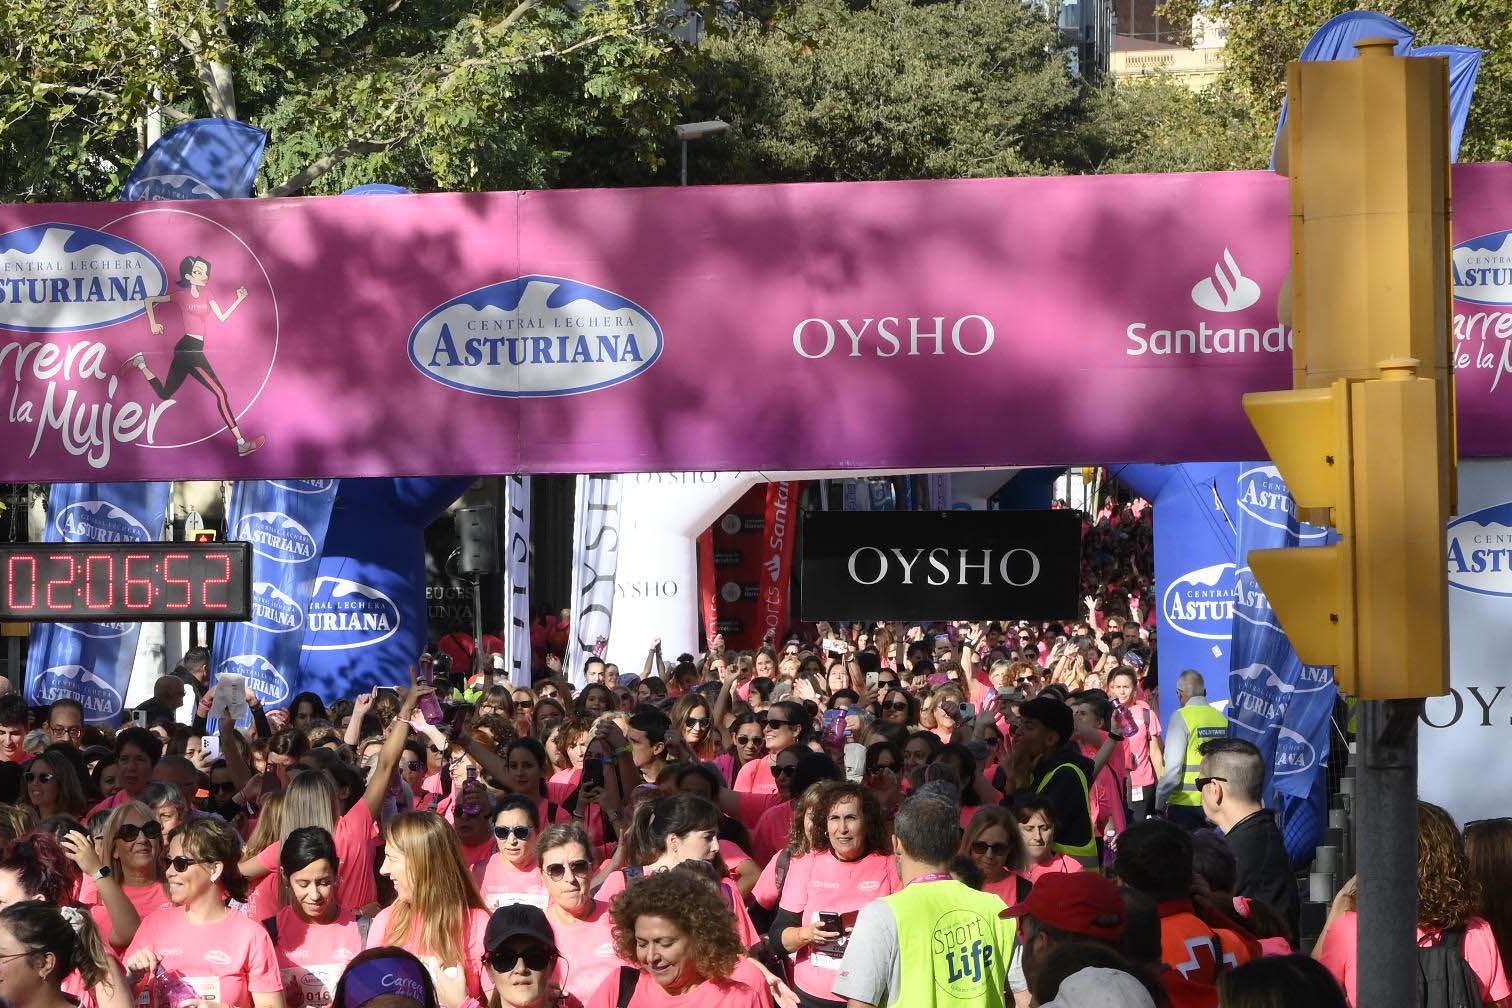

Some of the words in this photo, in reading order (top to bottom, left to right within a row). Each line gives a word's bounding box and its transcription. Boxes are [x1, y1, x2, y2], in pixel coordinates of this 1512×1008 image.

[71, 259, 142, 271] LECHERA
[1467, 256, 1512, 265] CENTRA
[467, 318, 542, 331] CENTRAL
[554, 316, 635, 329] LECHERA
[792, 315, 995, 359] OYSHO
[1126, 319, 1294, 357] Santand
[428, 323, 644, 367] ASTURIANA
[1476, 341, 1494, 369] la
[9, 383, 33, 424] la
[29, 375, 177, 468] Mujer
[238, 521, 310, 556] ASTURIANA
[1474, 534, 1512, 544] CENT
[8, 554, 231, 609] 02:06:52
[577, 473, 619, 653] OYSH
[847, 547, 1041, 587] OYSHO
[617, 580, 678, 599] YSHO
[309, 611, 390, 632] URIANA
[932, 917, 985, 960] Sport
[945, 941, 993, 984] Life
